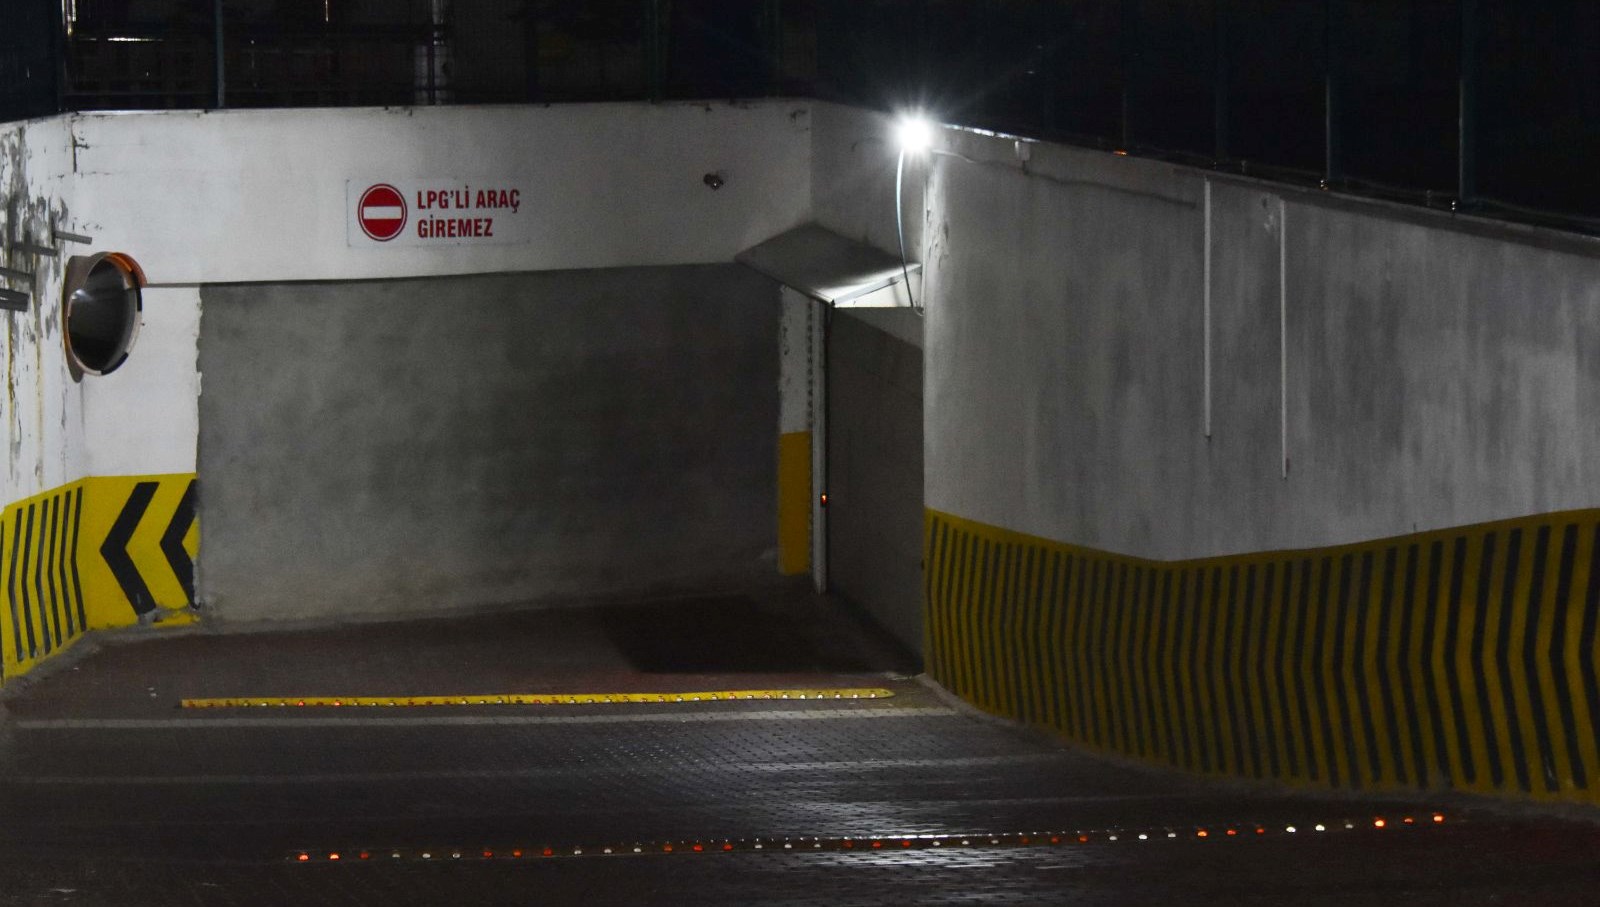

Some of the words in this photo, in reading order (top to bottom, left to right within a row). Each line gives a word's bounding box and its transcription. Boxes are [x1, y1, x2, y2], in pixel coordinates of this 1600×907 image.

[417, 185, 469, 209] LPG'Lİ
[476, 189, 520, 214] ARAÇ
[417, 214, 493, 238] GİREMEZ
